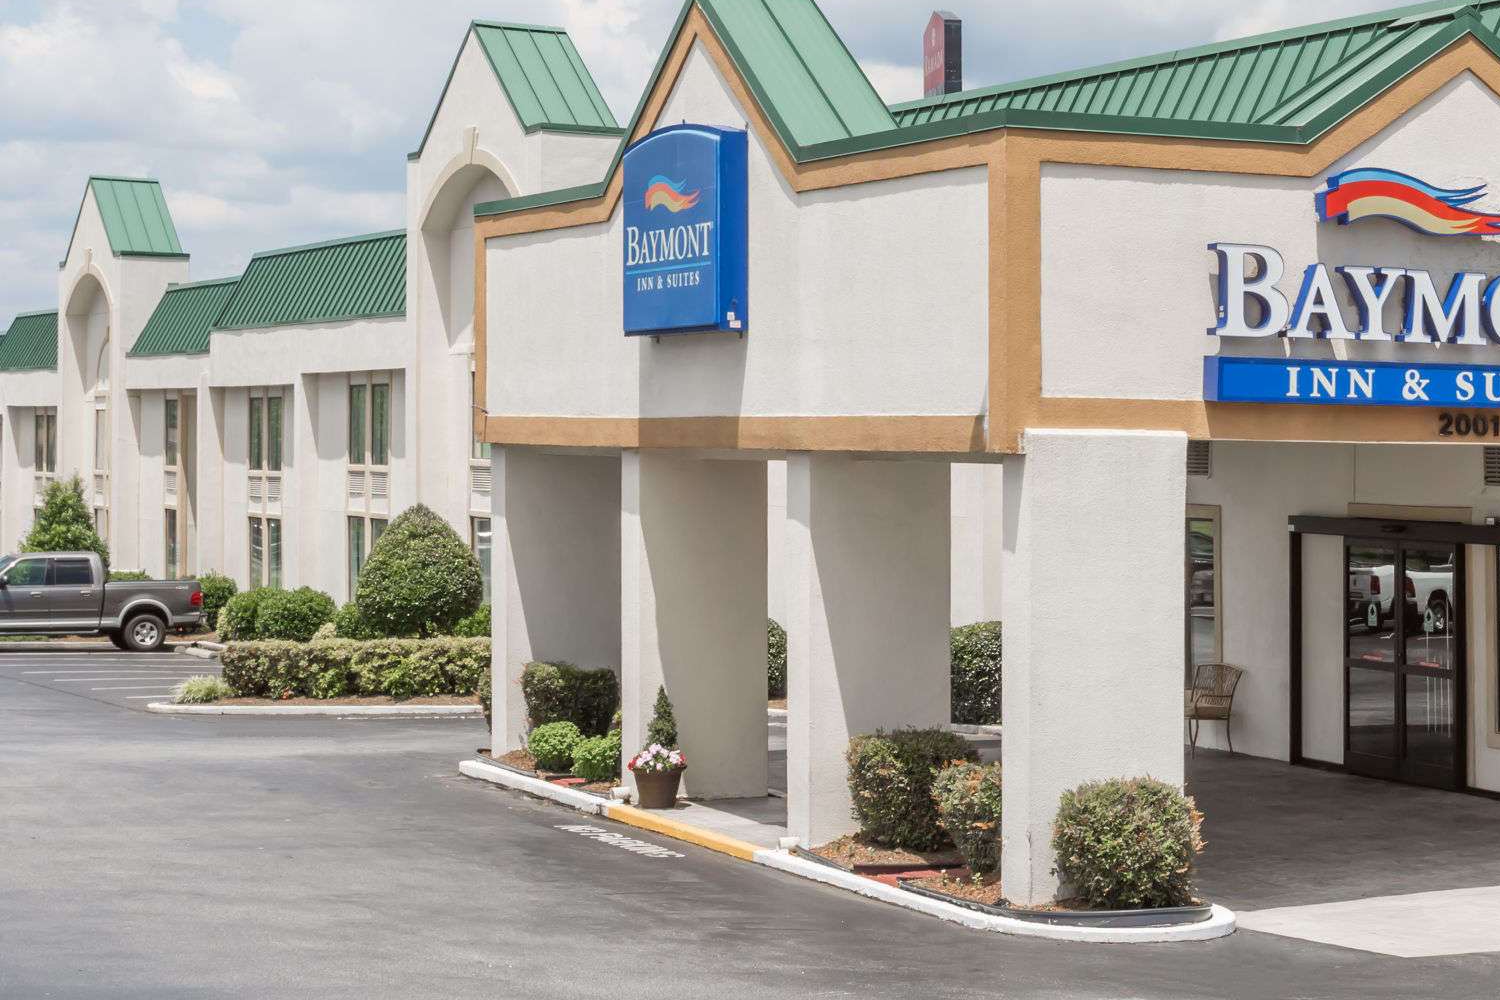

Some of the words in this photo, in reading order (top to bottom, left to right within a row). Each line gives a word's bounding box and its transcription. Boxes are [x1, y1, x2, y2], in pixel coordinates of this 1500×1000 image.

[626, 222, 712, 266] BAYMONT
[637, 277, 654, 292] INN
[657, 275, 664, 290] &
[667, 270, 700, 288] SUITES
[1286, 366, 1376, 399] INN
[1404, 369, 1430, 401] &
[1438, 412, 1500, 437] 2001
